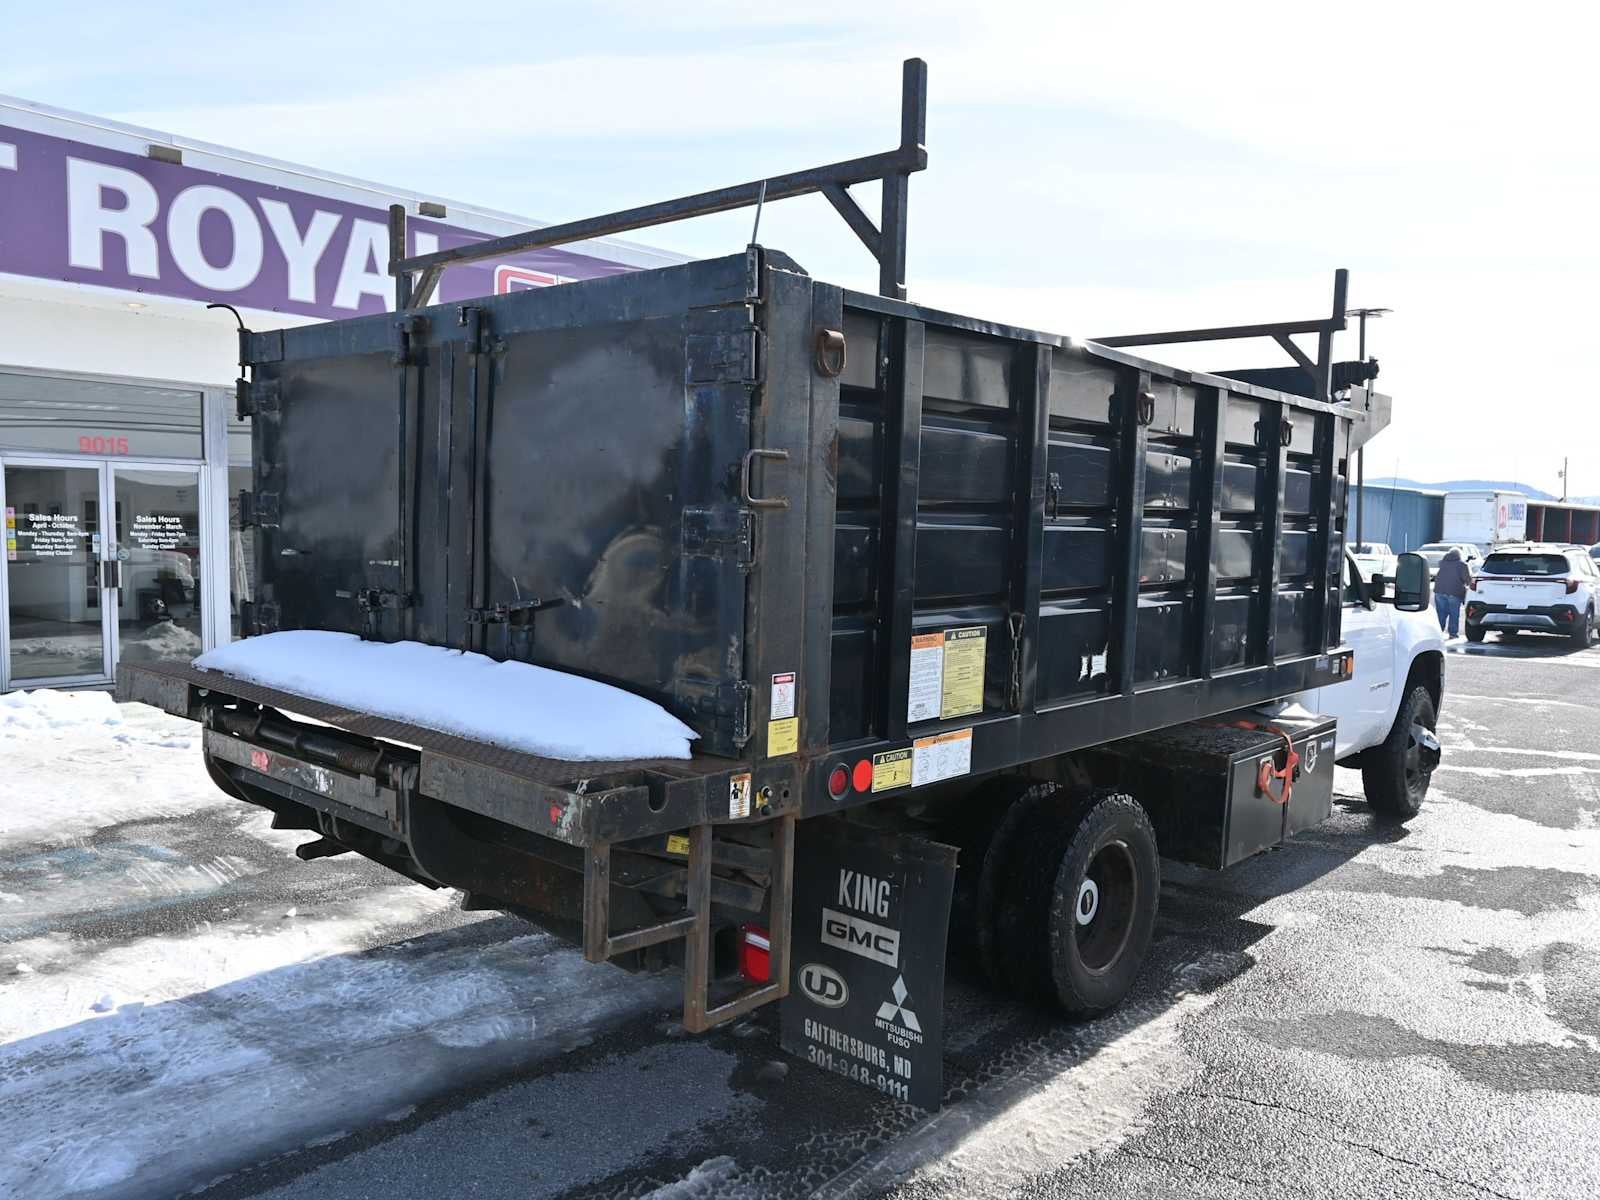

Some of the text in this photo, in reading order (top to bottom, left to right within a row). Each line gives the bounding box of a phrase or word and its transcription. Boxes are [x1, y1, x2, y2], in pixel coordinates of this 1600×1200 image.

[79, 435, 129, 456] 9015
[29, 513, 78, 522] Sales Hours
[136, 515, 180, 523] Sales Hours
[958, 630, 981, 638] CAUTION
[885, 751, 908, 763] CAUTION
[838, 868, 891, 918] KING
[825, 919, 895, 957] GMC
[804, 969, 844, 1002] UD
[875, 1017, 923, 1044] MITSUBISHI
[887, 1032, 911, 1049] FUSO
[804, 1018, 912, 1080] GAITHERSBURG, MD
[807, 1044, 909, 1103] 301-948-9111
